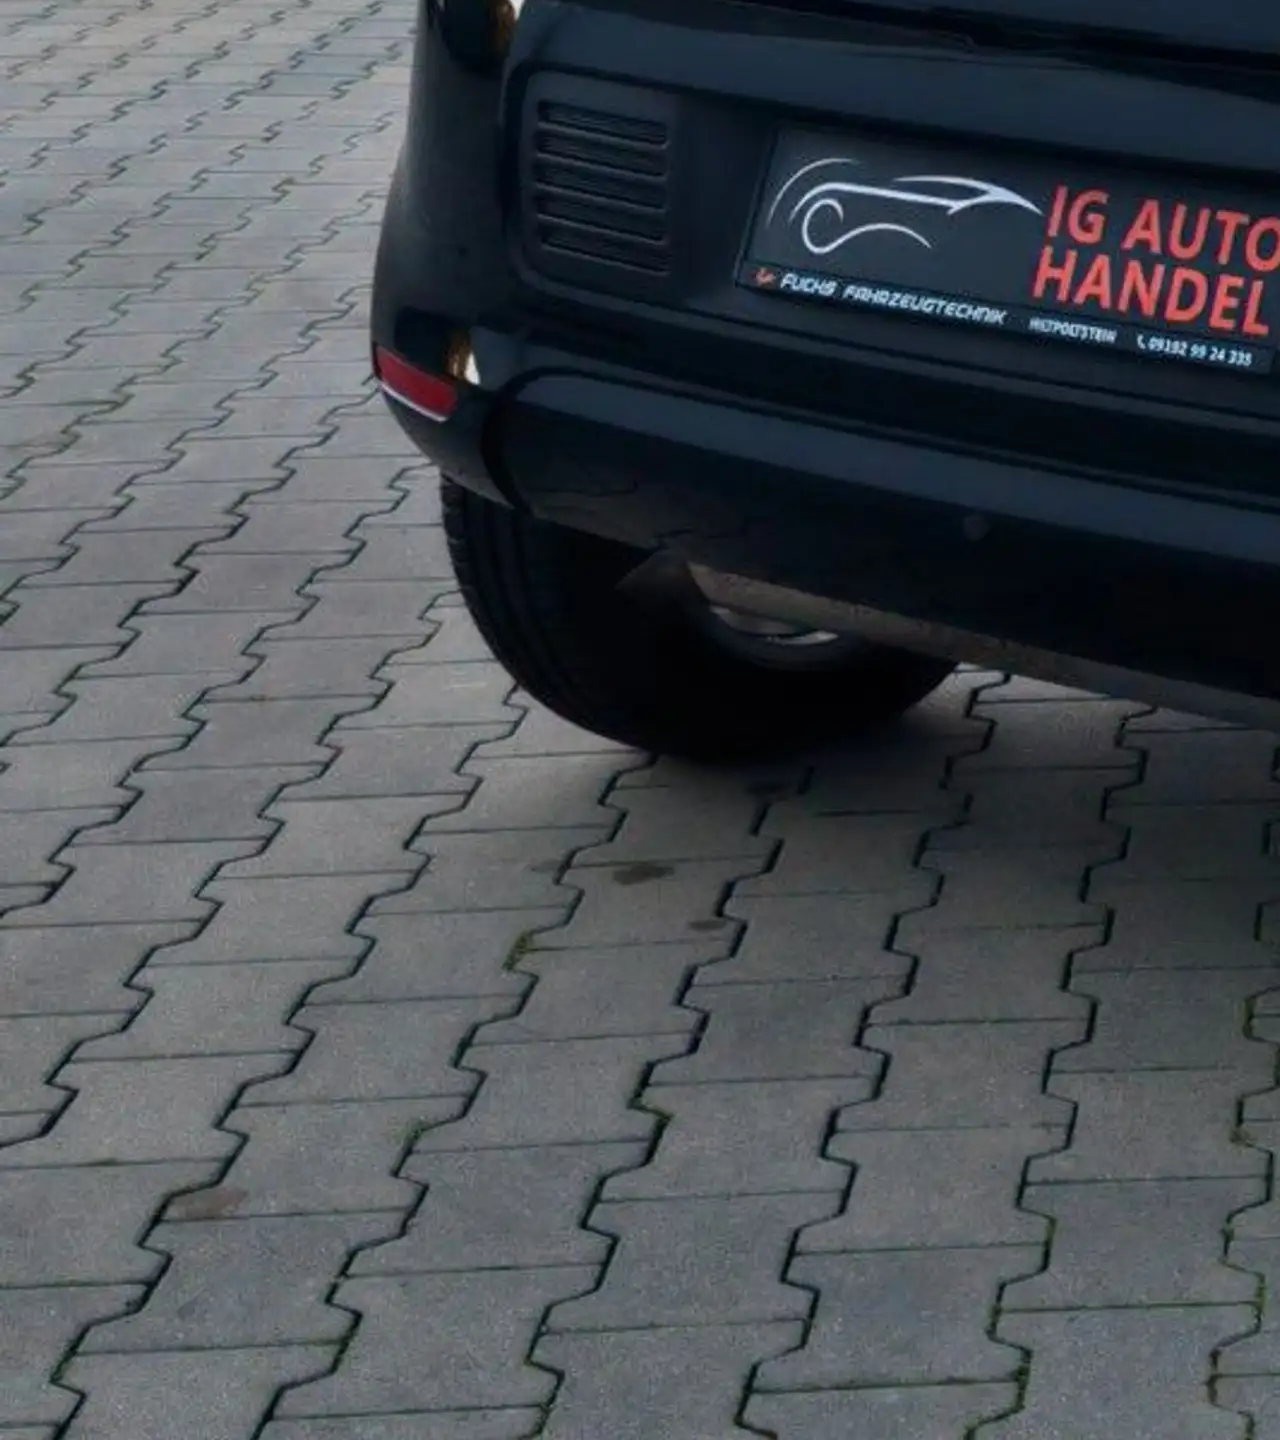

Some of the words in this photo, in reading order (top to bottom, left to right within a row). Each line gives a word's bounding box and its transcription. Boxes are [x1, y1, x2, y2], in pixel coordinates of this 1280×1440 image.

[1047, 186, 1108, 243] IG
[780, 271, 837, 297] FUCHS
[842, 284, 1008, 324] FAHRZEUGTECHNIK
[1032, 246, 1270, 336] HANDEL
